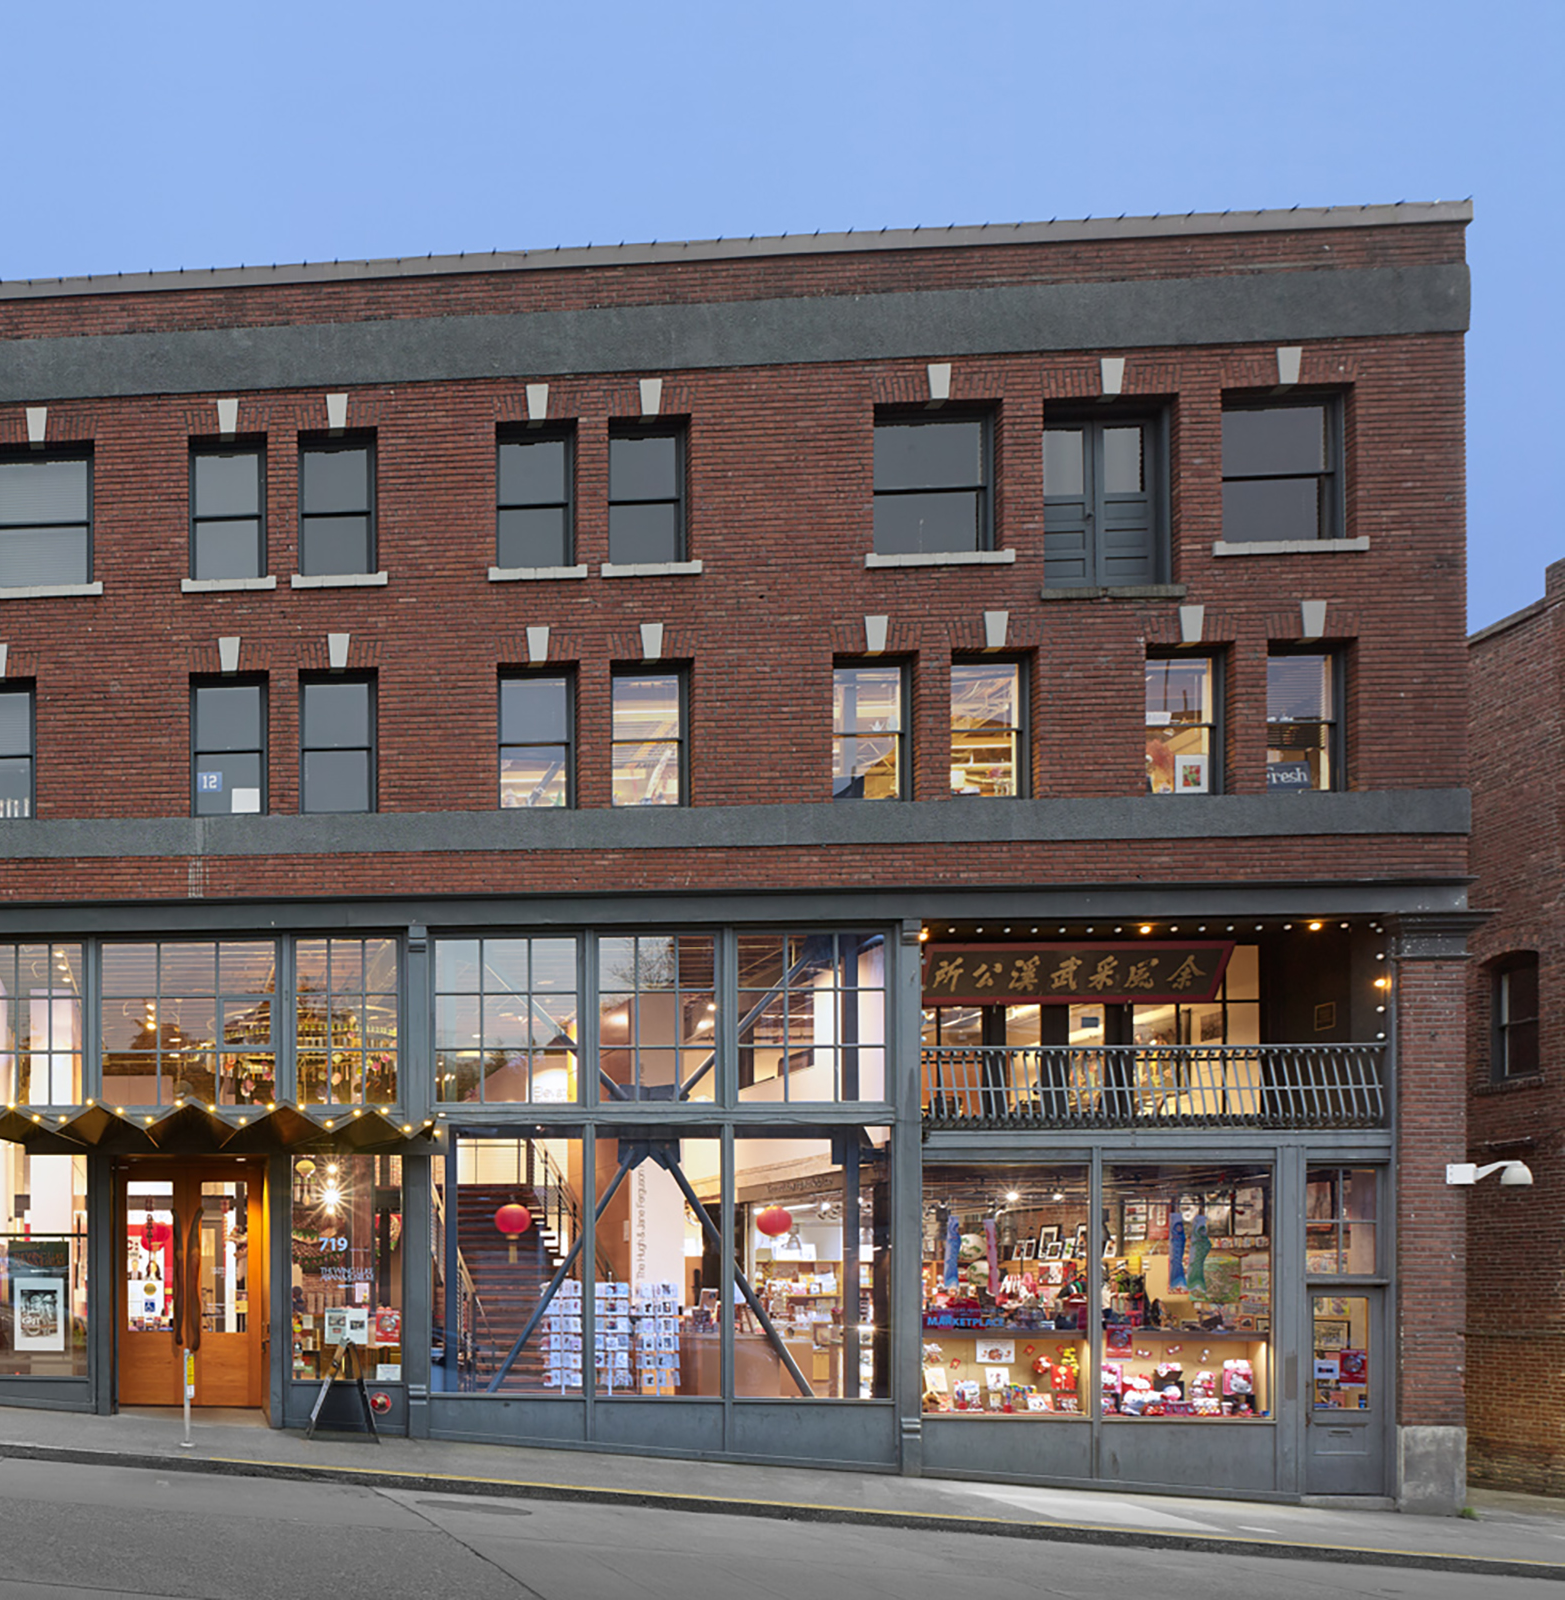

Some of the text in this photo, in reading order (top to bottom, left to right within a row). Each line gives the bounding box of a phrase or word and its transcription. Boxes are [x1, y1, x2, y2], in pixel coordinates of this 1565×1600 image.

[203, 775, 218, 789] 12
[319, 1237, 348, 1251] 719
[927, 1315, 1005, 1327] MARKETPLACE
